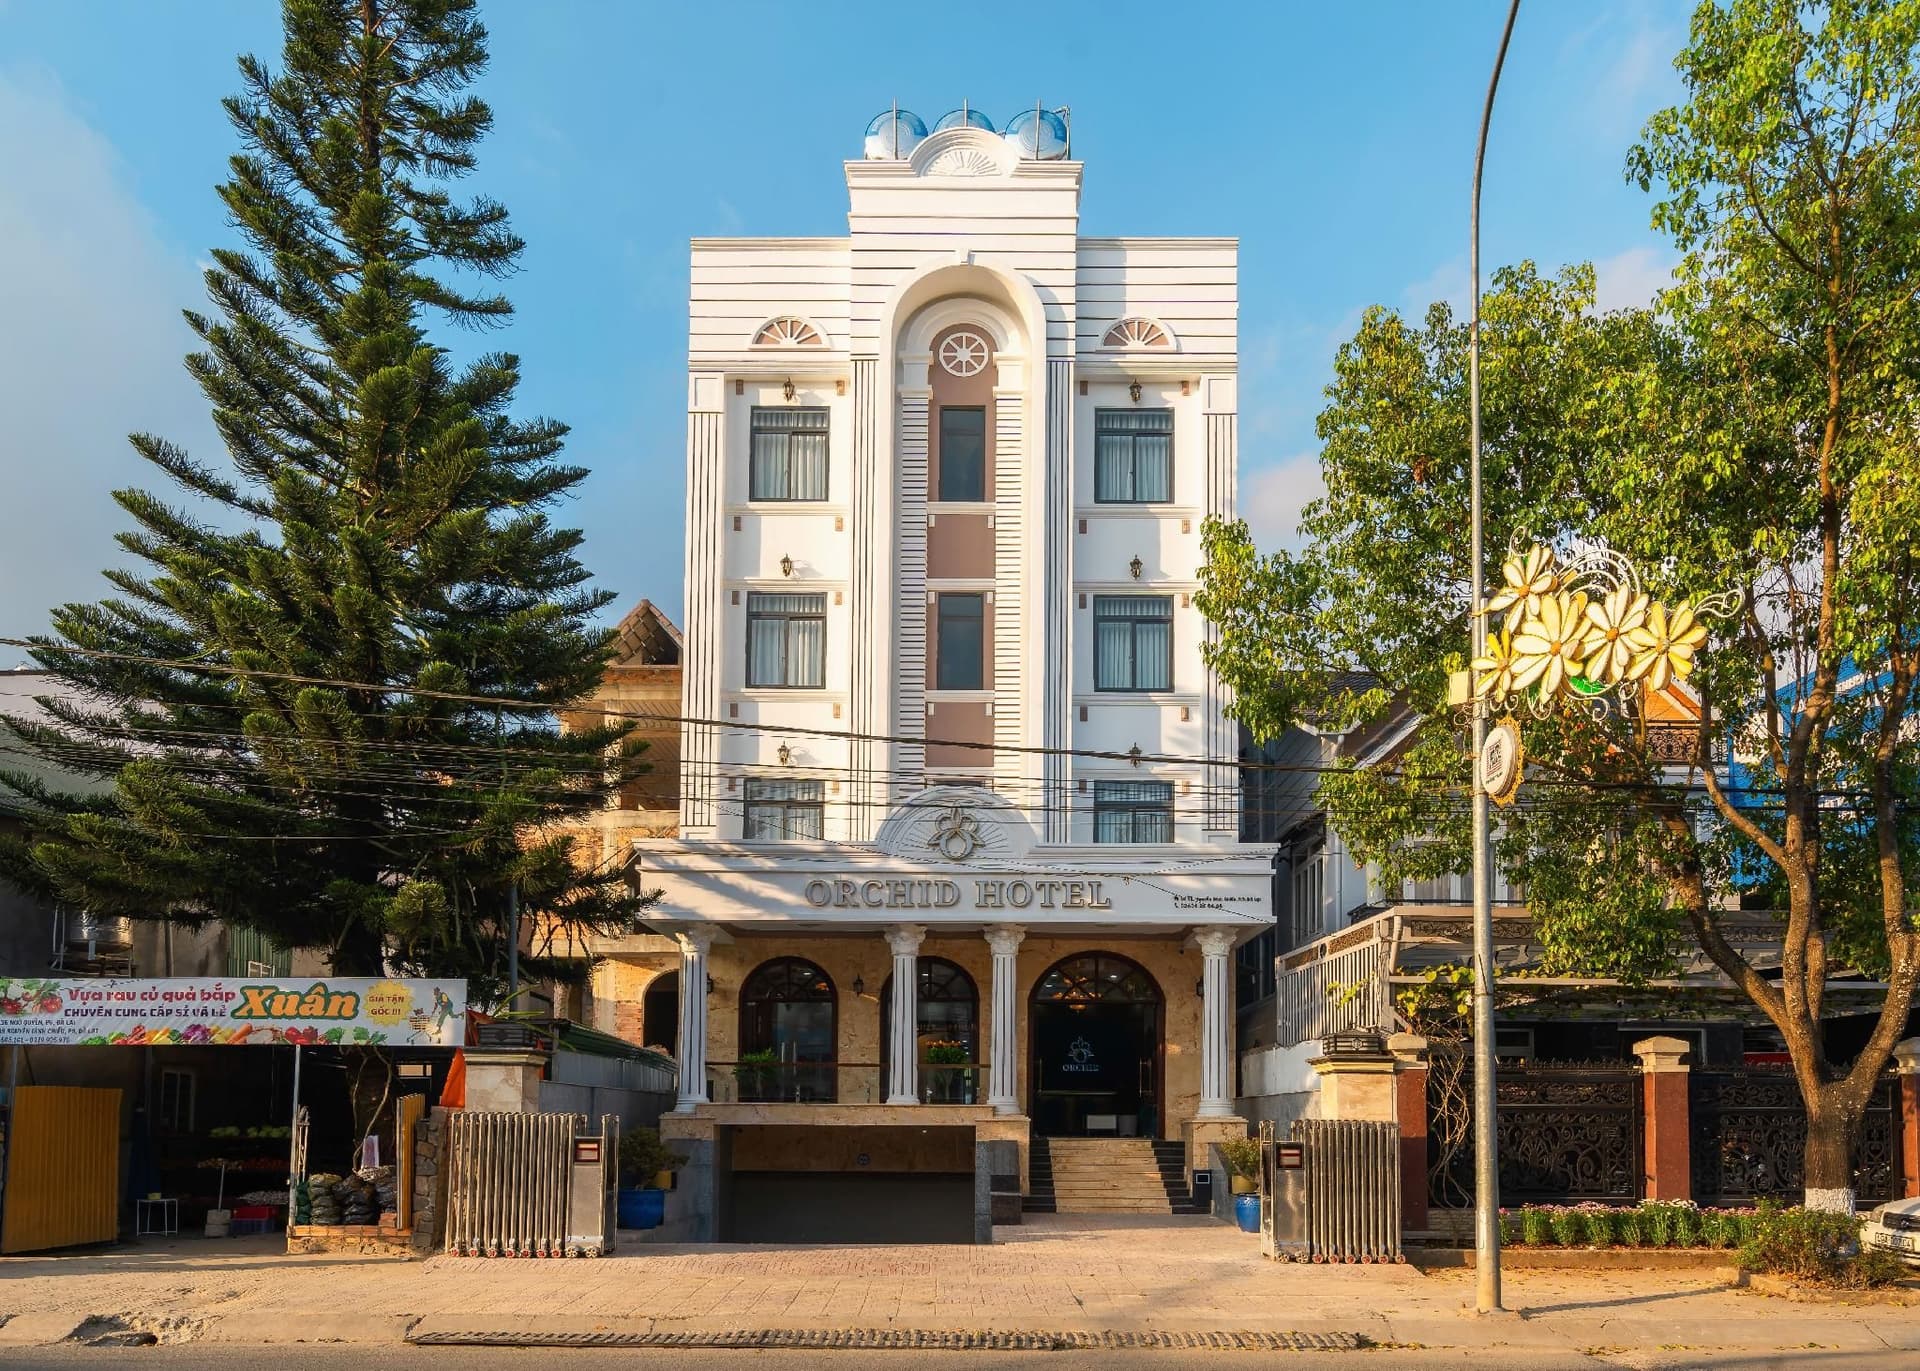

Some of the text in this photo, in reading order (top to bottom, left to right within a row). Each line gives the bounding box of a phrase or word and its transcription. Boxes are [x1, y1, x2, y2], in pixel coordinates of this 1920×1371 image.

[805, 880, 1112, 908] ORCHID HOTEL
[68, 983, 236, 1005] Vựa rau củ quả bắp
[232, 982, 359, 1019] Xuân
[64, 1006, 112, 1017] CHUYÊN
[115, 1008, 147, 1017] CUNG
[150, 1003, 173, 1017] CẤP
